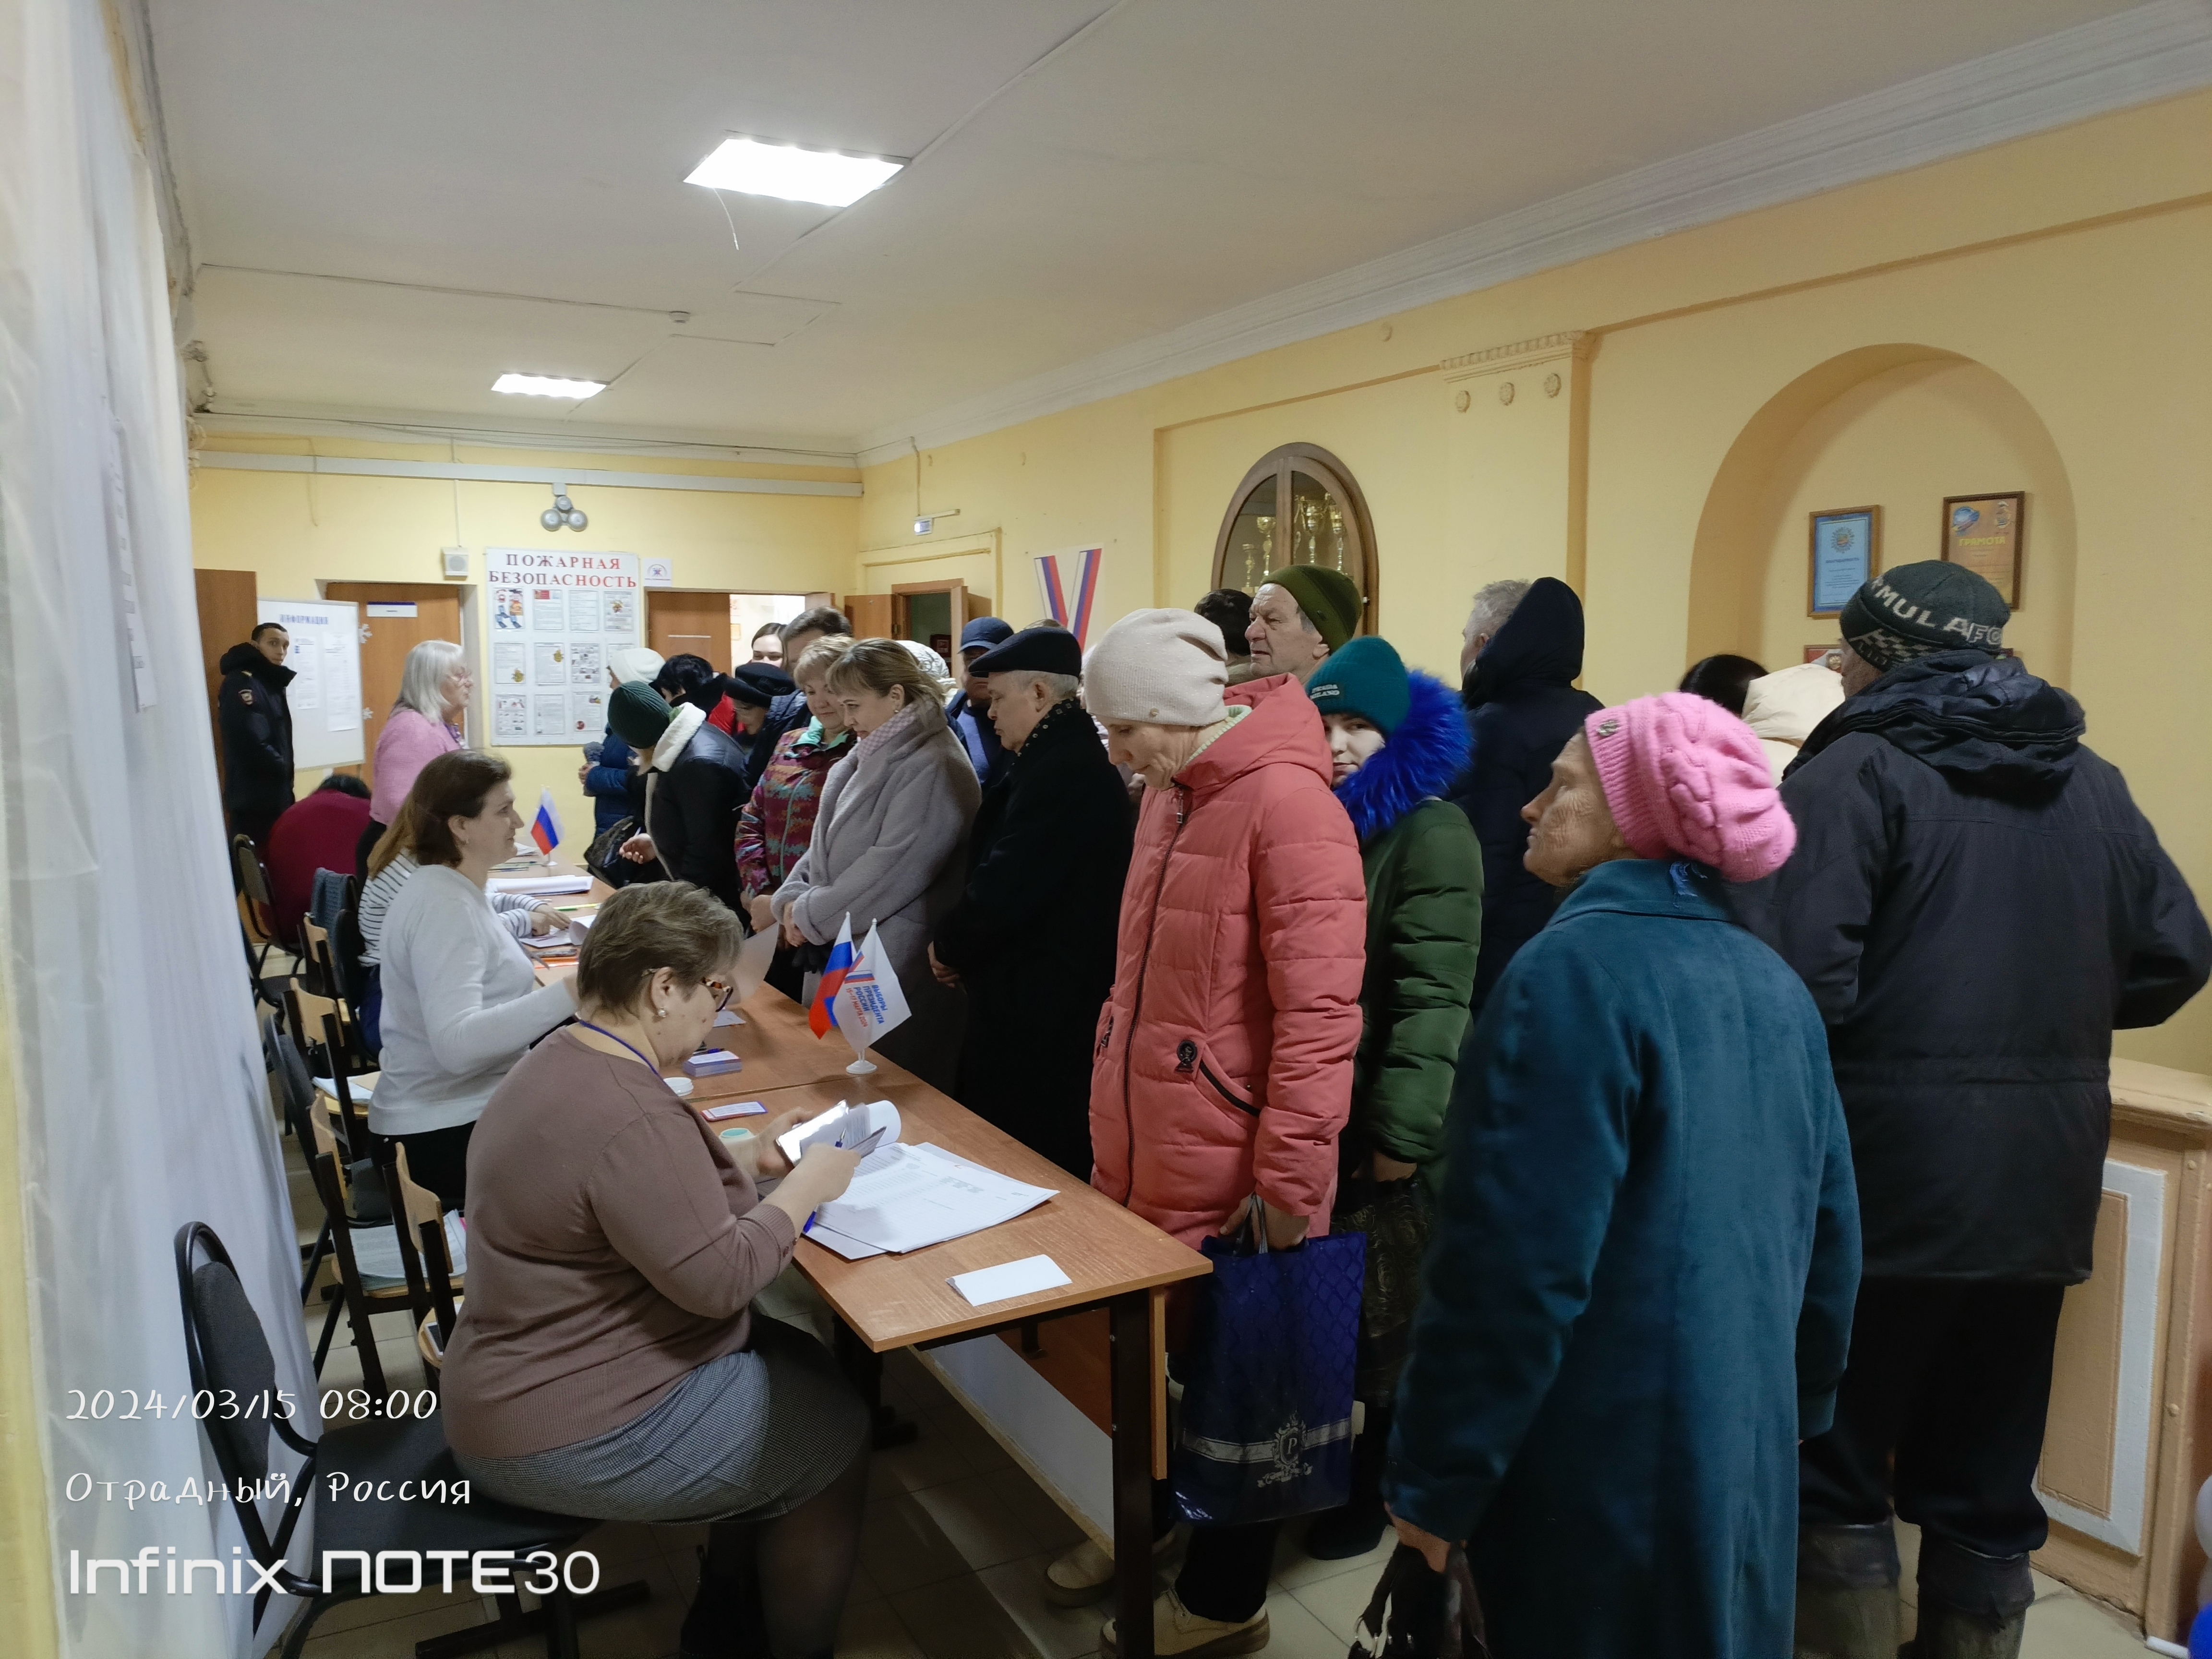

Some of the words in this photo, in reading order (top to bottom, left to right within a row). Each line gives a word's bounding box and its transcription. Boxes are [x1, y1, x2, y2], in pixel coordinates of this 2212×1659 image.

[505, 553, 621, 569] ПОЖАРНАЯ
[489, 570, 637, 588] БЕЗОПАСНОСТЬ
[852, 1001, 864, 1016] МАРТА
[853, 986, 871, 1011] РОССИИ
[862, 986, 885, 1024] ПРЕЗИДЕНТА
[871, 985, 888, 1011] ВЫБОРЫ
